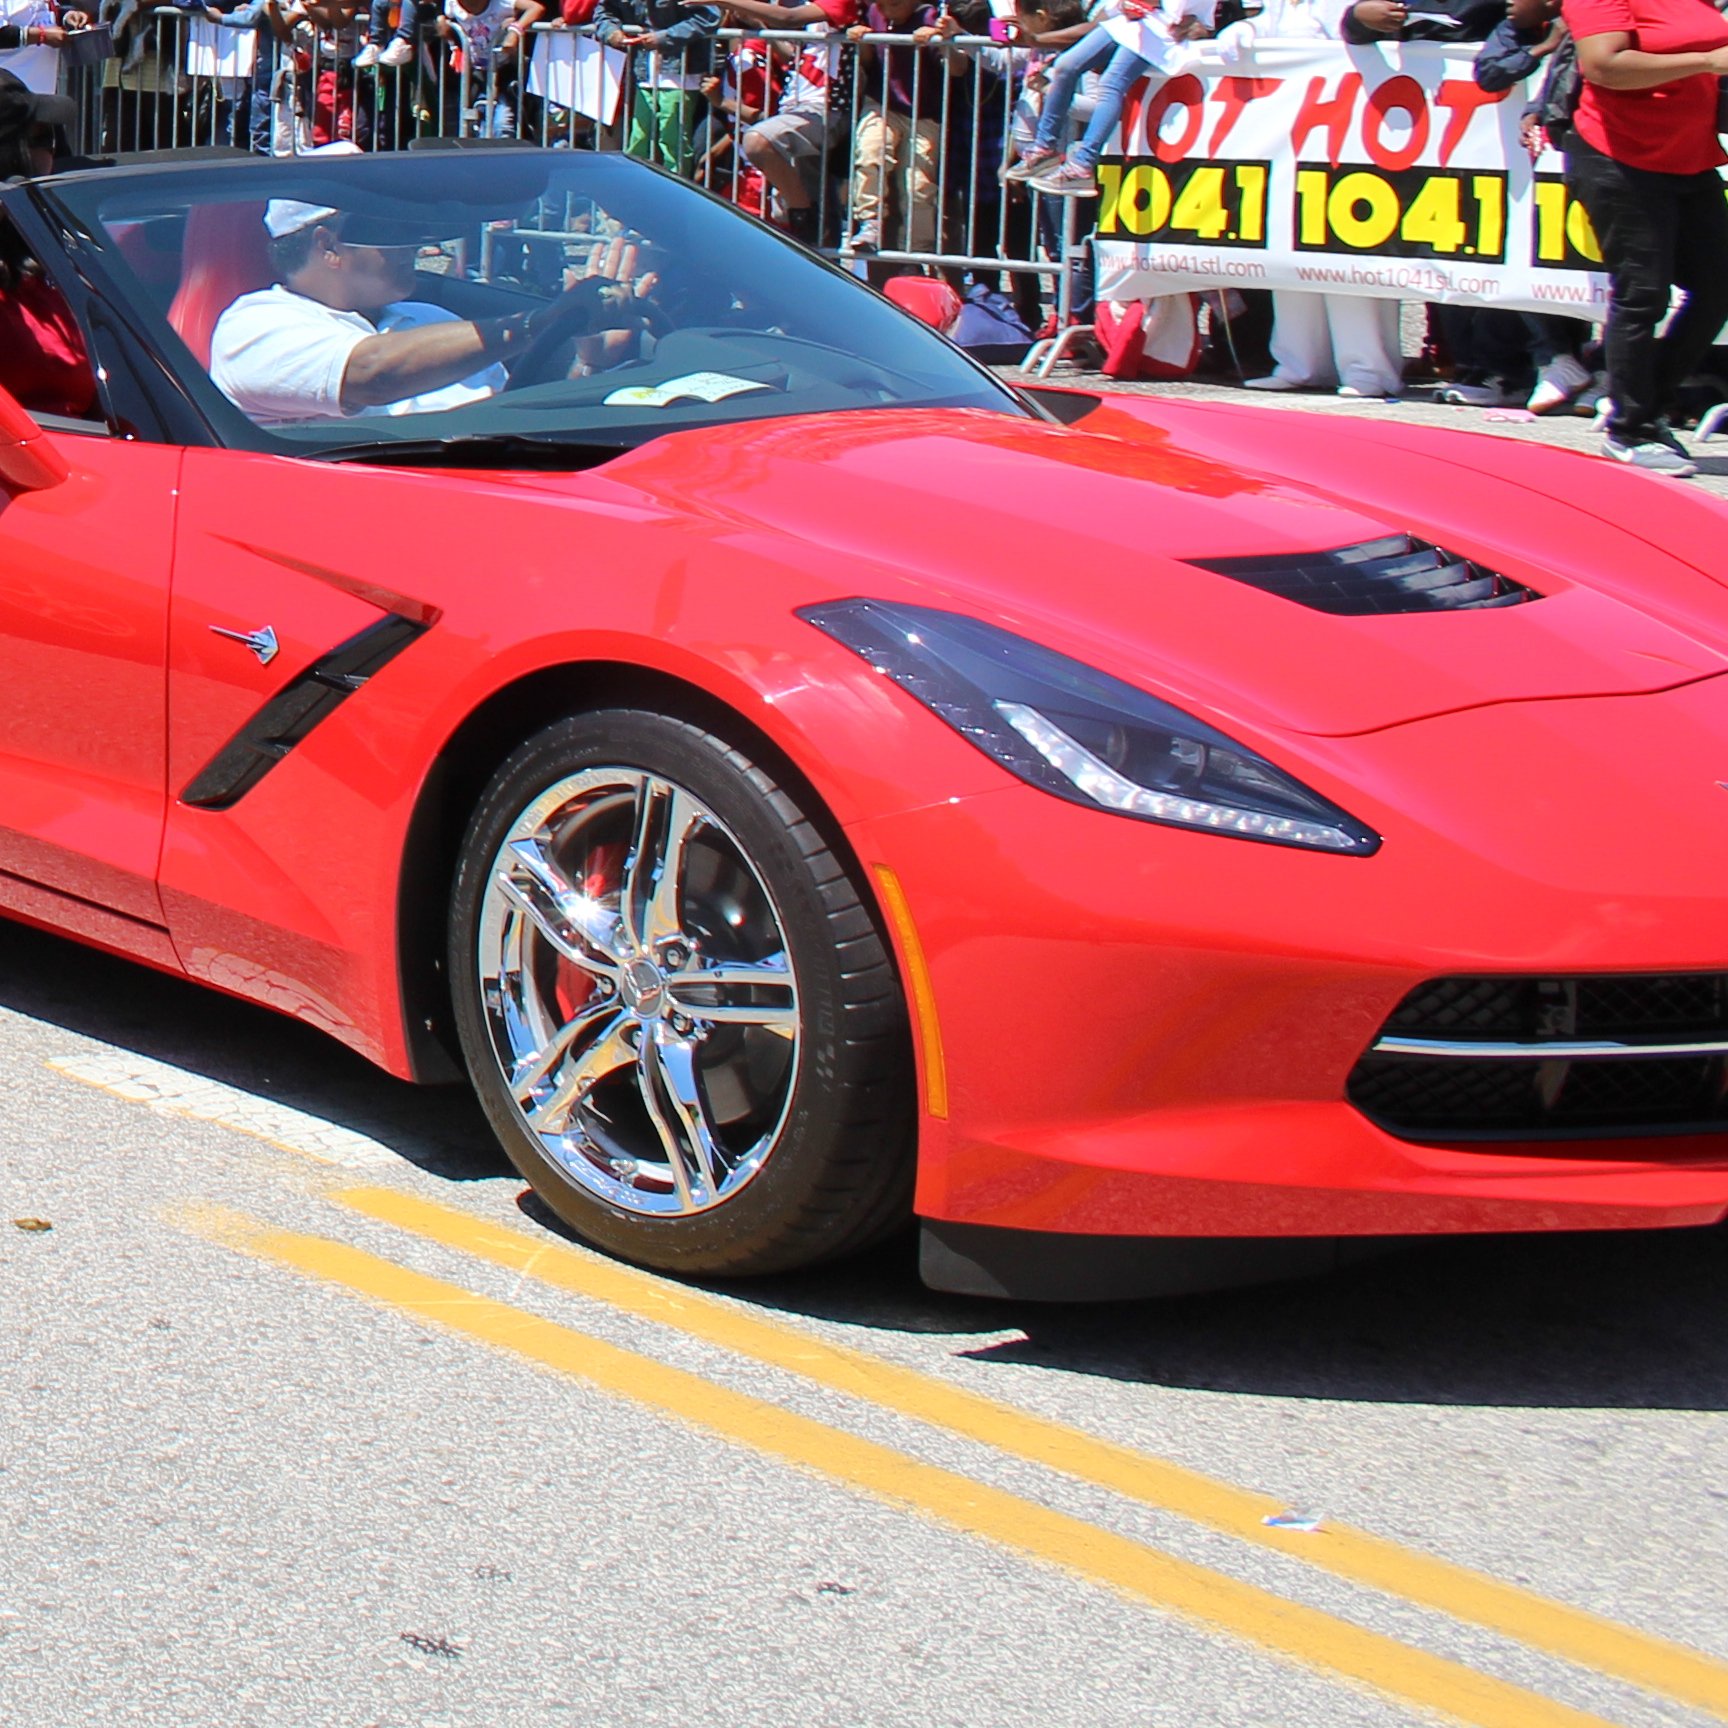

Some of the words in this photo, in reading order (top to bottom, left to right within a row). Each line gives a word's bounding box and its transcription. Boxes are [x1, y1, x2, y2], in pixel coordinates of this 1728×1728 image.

[1290, 72, 1517, 172] HOT
[1097, 164, 1266, 241] 104.1
[1296, 170, 1504, 257] 104.1
